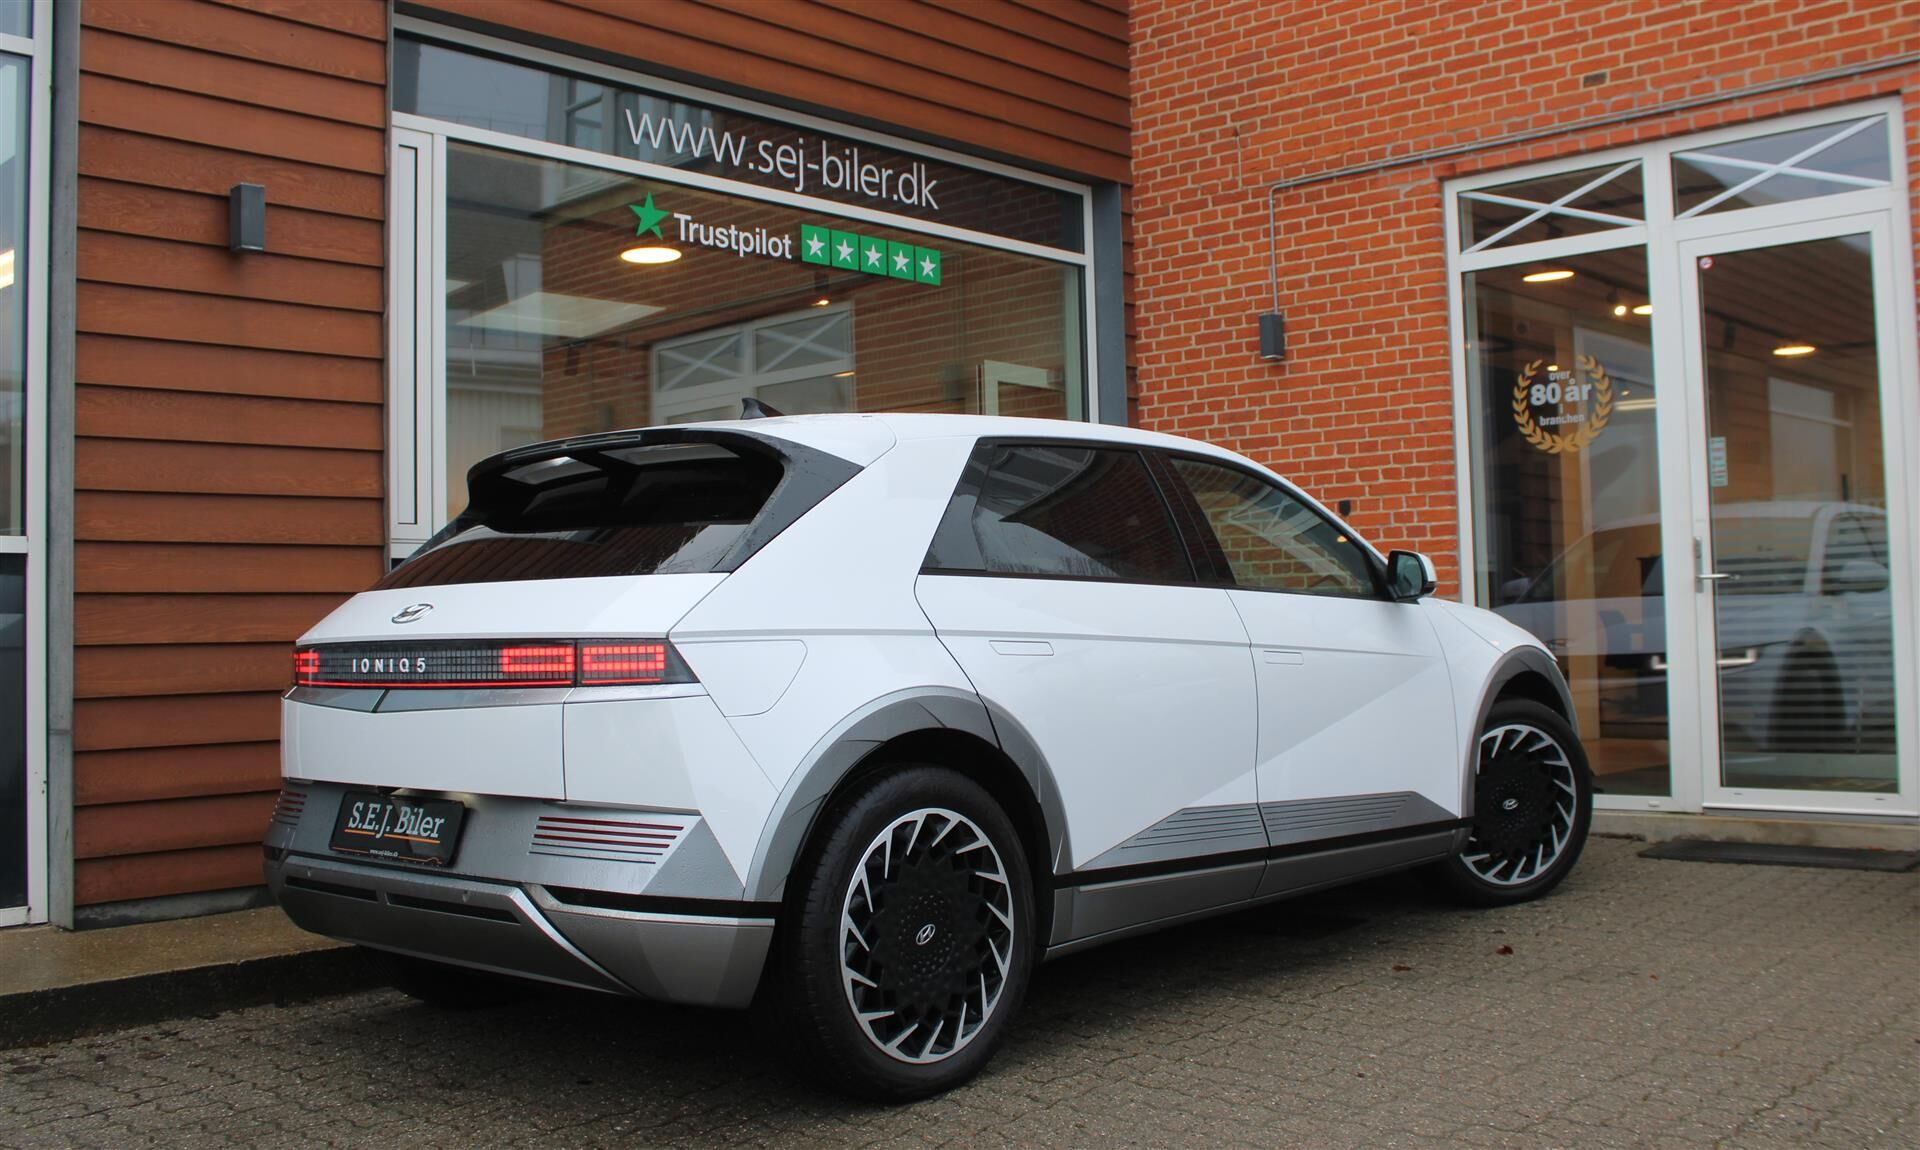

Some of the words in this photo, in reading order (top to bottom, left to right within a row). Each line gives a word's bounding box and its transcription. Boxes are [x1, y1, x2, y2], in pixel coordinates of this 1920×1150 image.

[625, 108, 940, 210] www.sej-biler.dk
[673, 212, 793, 260] Trustpilot
[1530, 382, 1562, 406] 80
[1565, 378, 1592, 402] år
[1548, 370, 1572, 381] over
[352, 657, 410, 673] IONIQ
[416, 657, 426, 673] 5
[347, 801, 393, 839] S.E.J.
[393, 805, 446, 839] Biler
